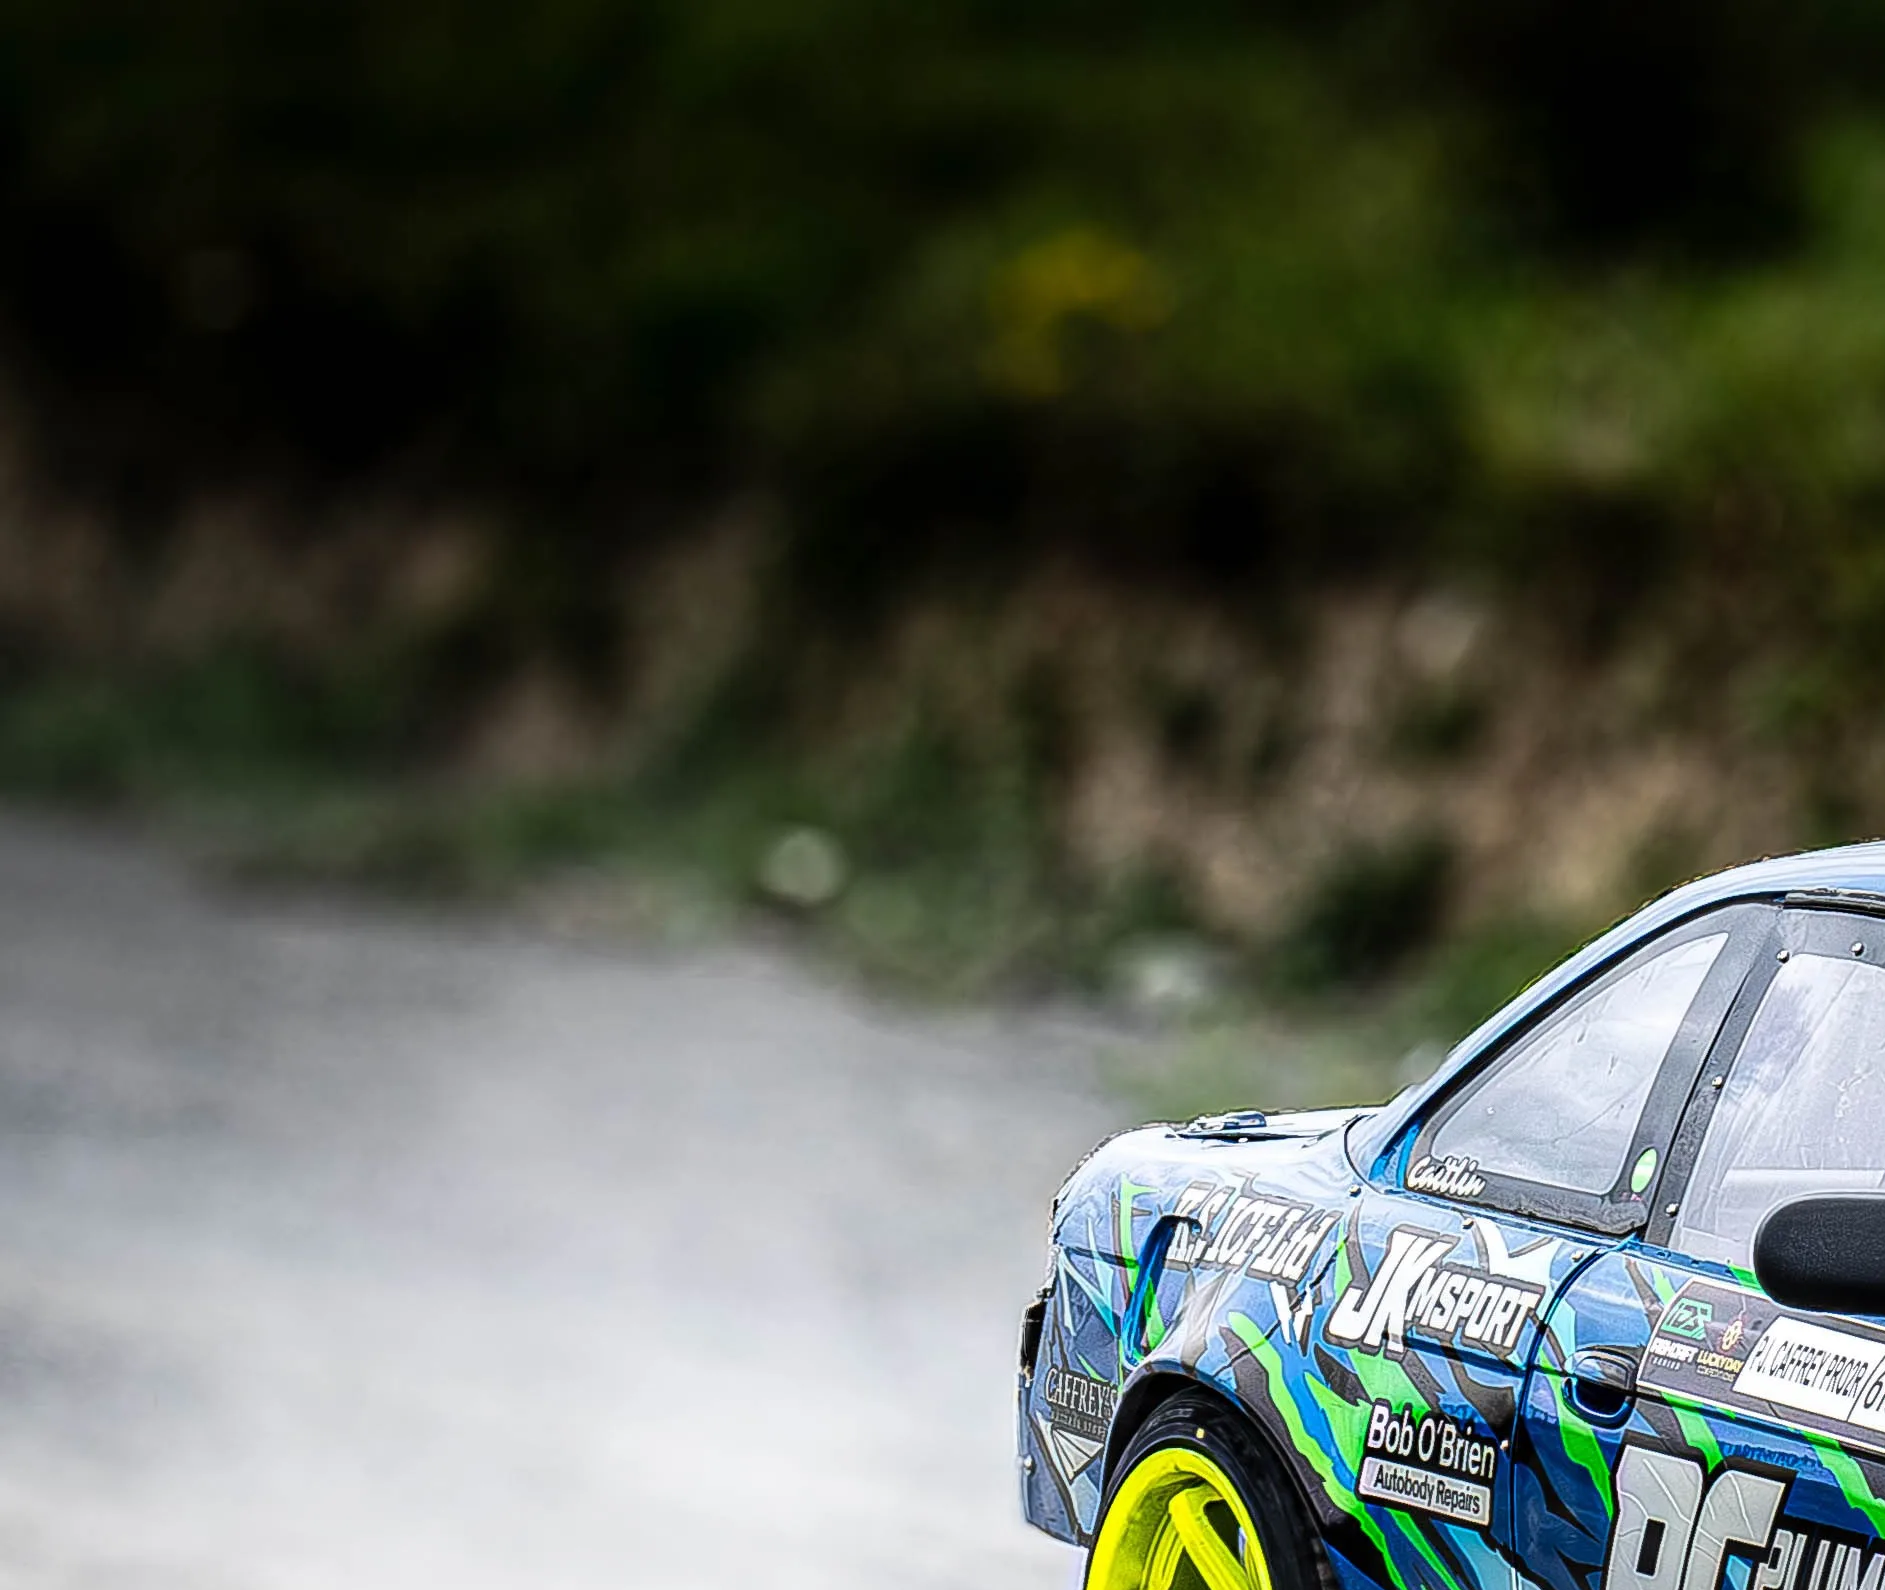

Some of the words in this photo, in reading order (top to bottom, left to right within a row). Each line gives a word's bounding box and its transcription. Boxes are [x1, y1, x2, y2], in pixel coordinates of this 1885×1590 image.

[1768, 1340, 1832, 1388] CAFFREY
[1818, 1354, 1869, 1399] PRO2R
[1367, 1404, 1414, 1456] Bob
[1418, 1418, 1496, 1479] O'Brien
[1373, 1463, 1435, 1507] Autobody
[1435, 1480, 1481, 1514] Repairs
